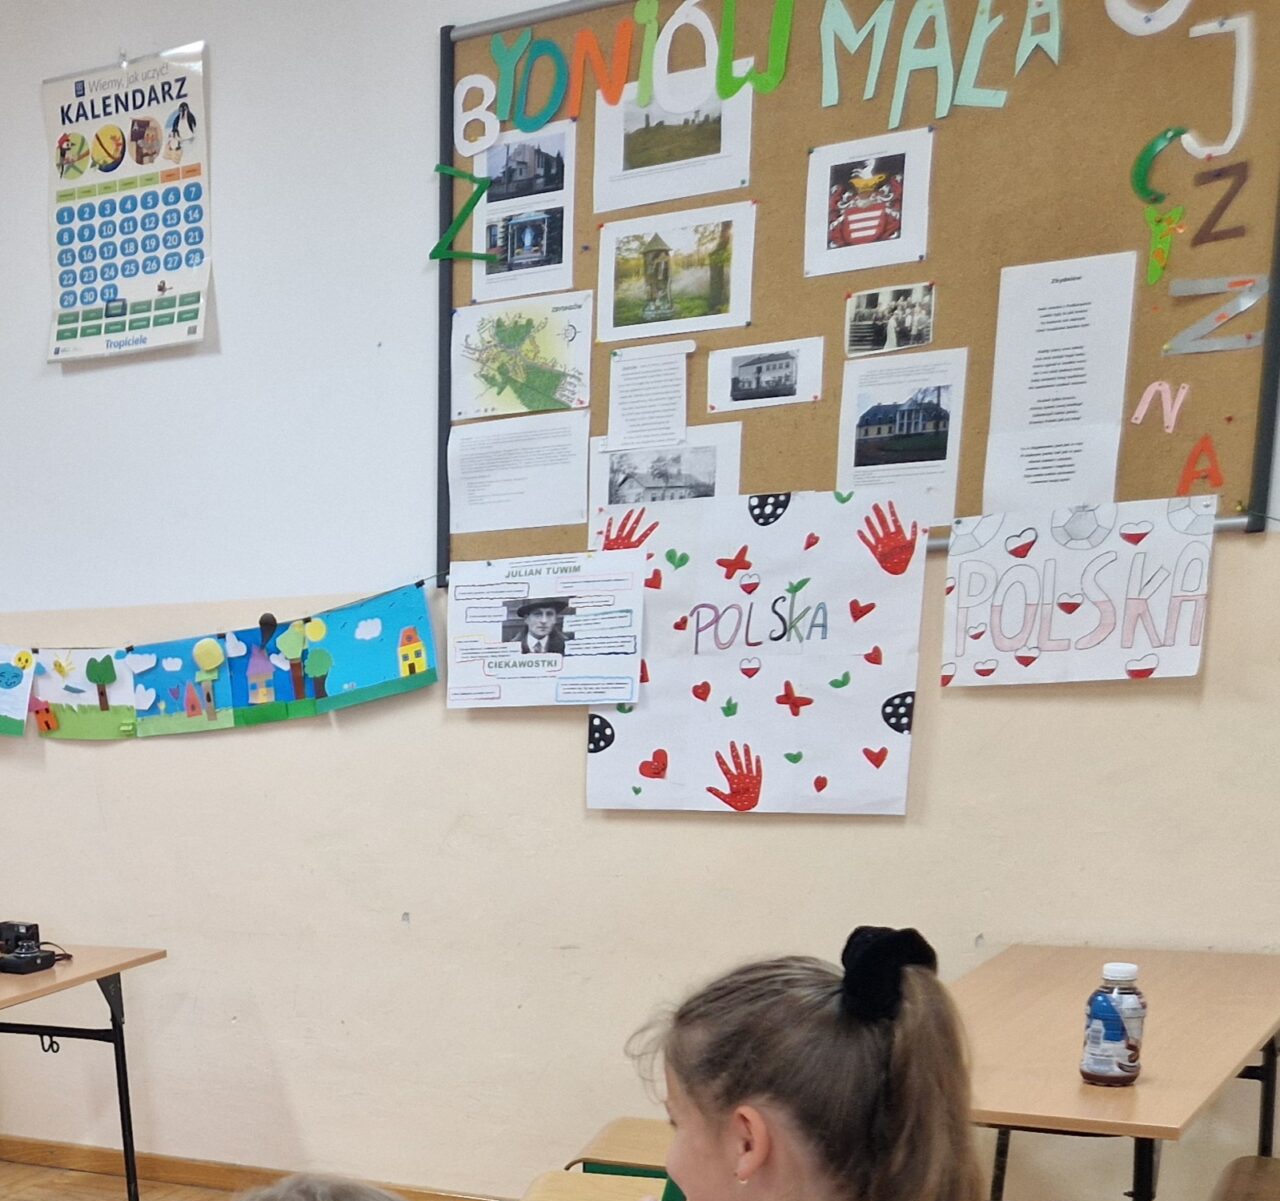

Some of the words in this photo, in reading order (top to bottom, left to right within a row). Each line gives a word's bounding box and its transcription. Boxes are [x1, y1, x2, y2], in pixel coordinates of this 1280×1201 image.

[60, 76, 188, 126] KALENDARZ
[102, 225, 113, 236] 10
[123, 221, 134, 232] 11
[144, 217, 156, 228] 12
[166, 213, 177, 224] 13
[188, 209, 200, 221] 14
[62, 252, 73, 264] 15
[82, 249, 93, 261] 16
[103, 245, 114, 257] 17
[124, 242, 135, 254] 18
[145, 239, 156, 251] 19
[166, 235, 178, 246] 20
[188, 231, 200, 243] 21
[62, 273, 74, 285] 22
[83, 270, 94, 281] 23
[103, 266, 115, 278] 24
[124, 263, 136, 274] 25
[145, 259, 157, 271] 26
[167, 255, 179, 268] 27
[188, 252, 201, 264] 28
[63, 294, 74, 306] 29
[83, 291, 95, 302] 30
[103, 287, 114, 299] 31
[105, 335, 148, 349] Tropiciele
[505, 568, 543, 578] JULIAN
[546, 565, 581, 575] TUWIM
[955, 541, 1208, 657] POLSKA
[689, 590, 828, 654] POLSKA
[487, 659, 558, 669] CIEKAWOSTKI
